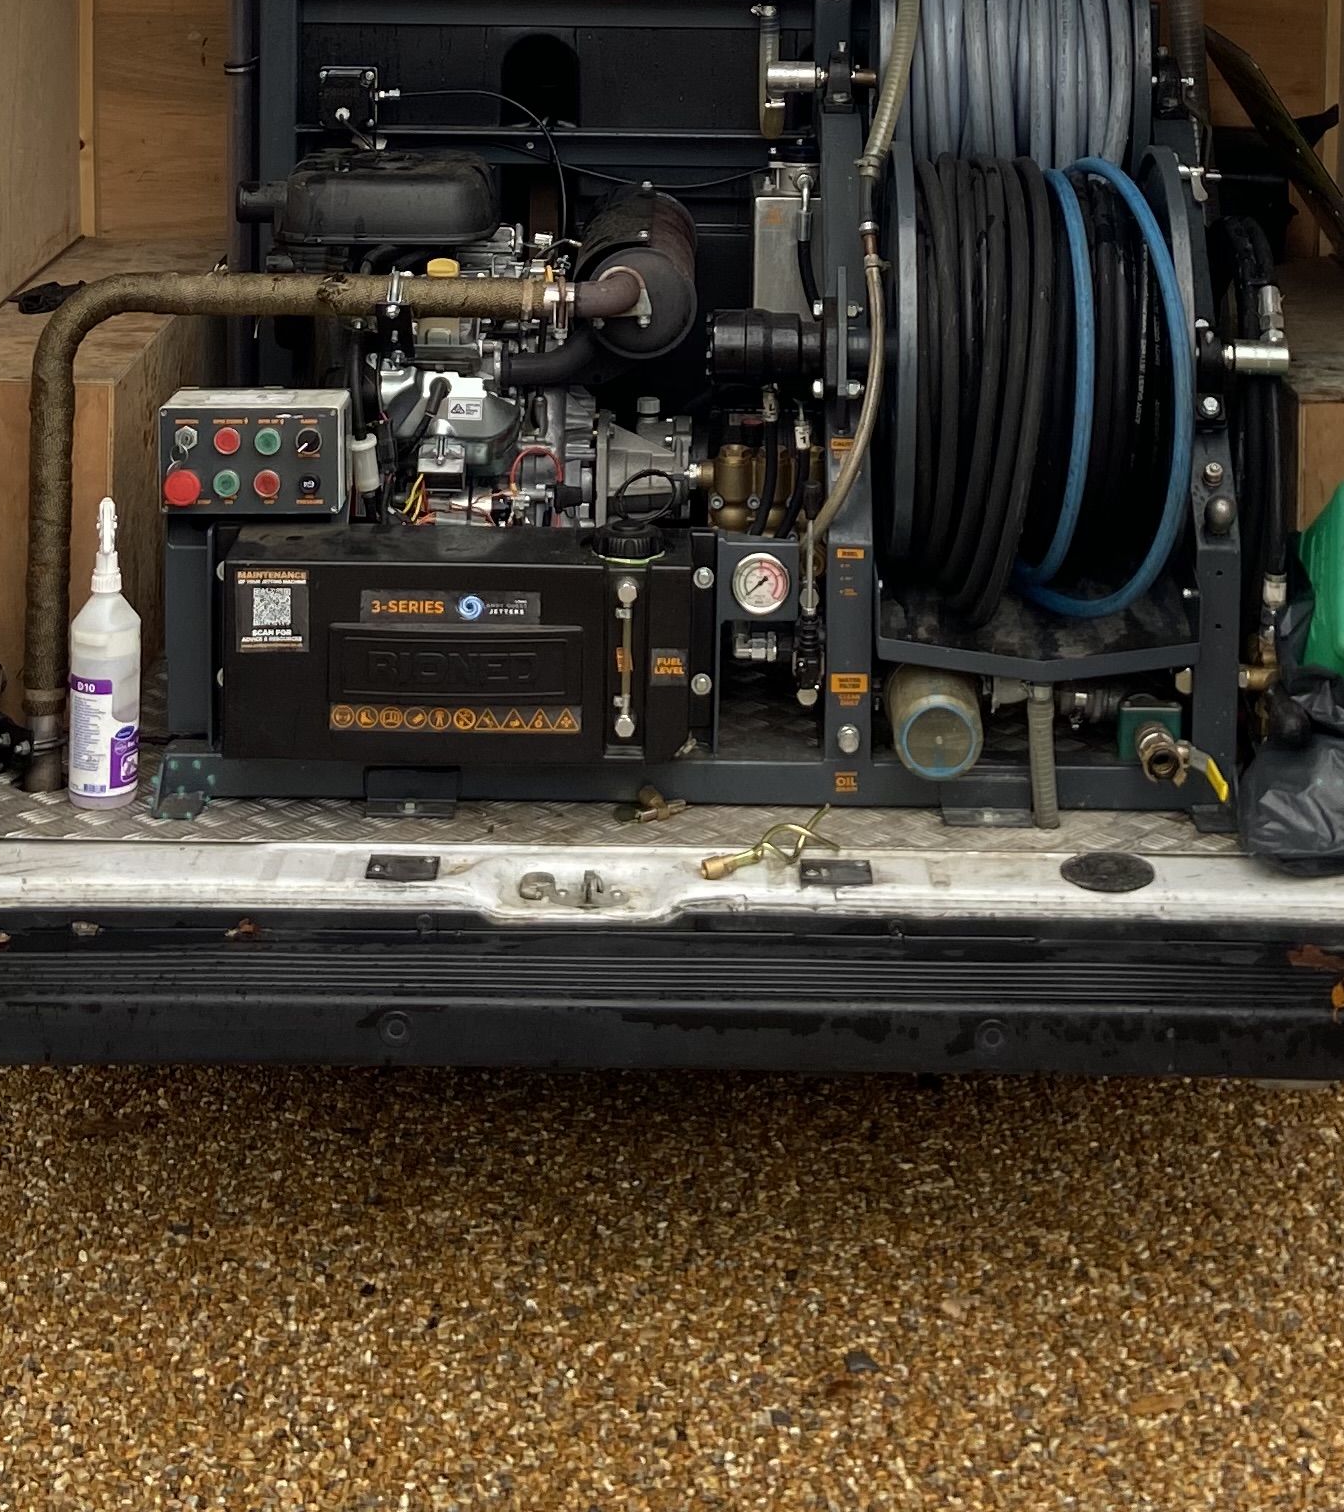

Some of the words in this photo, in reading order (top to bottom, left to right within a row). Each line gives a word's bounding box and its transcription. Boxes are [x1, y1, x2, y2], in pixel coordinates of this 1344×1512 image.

[238, 571, 307, 579] MAINTENANCE
[371, 600, 444, 614] 3-SERIES
[657, 657, 682, 665] FUEL
[655, 667, 684, 675] LEVEL
[77, 681, 95, 693] D10
[836, 777, 857, 786] OIL
